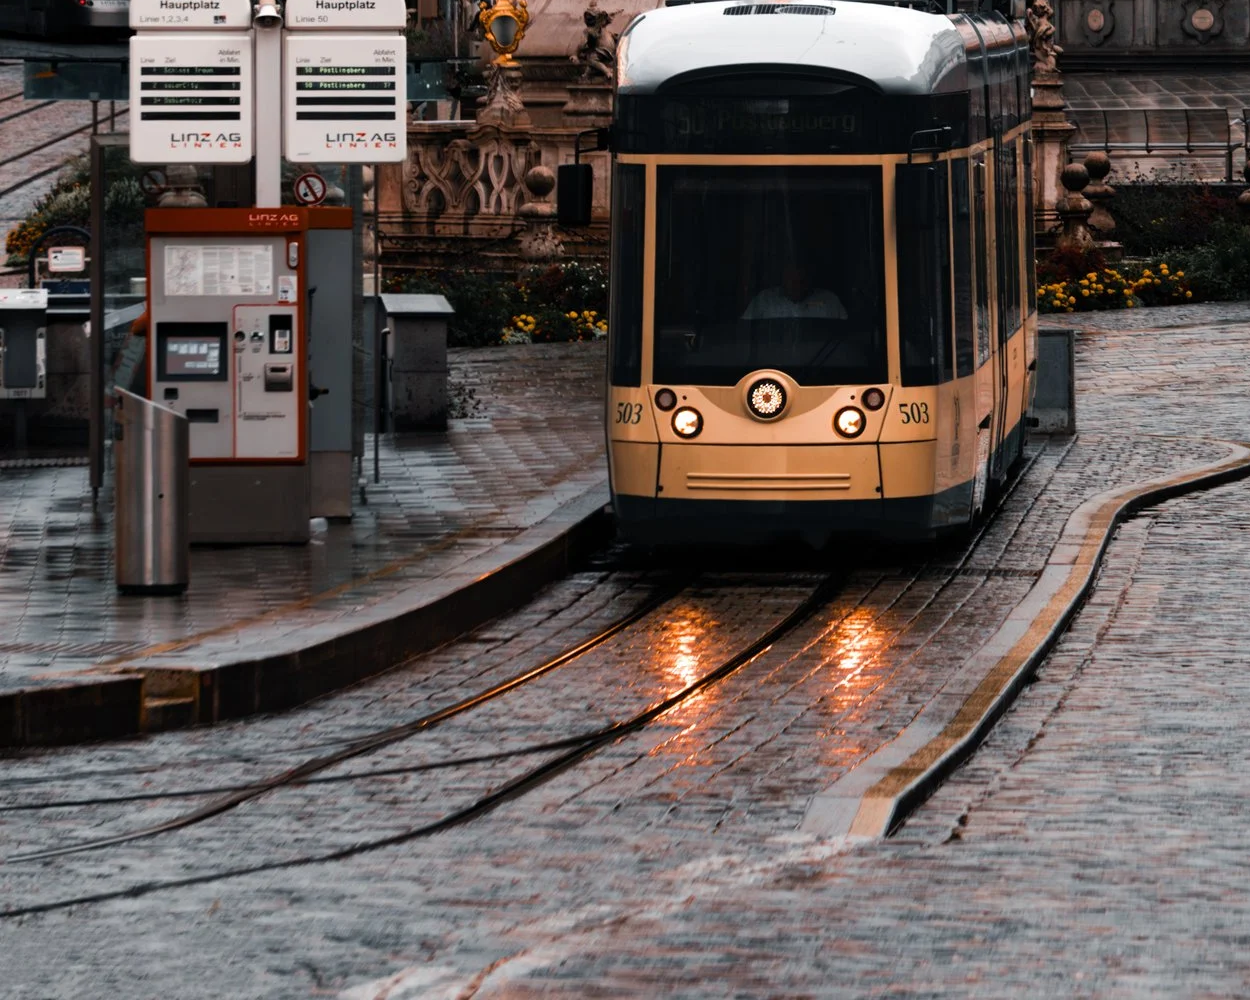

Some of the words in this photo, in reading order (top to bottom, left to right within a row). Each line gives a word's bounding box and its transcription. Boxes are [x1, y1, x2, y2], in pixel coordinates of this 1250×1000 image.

[160, 0, 220, 11] Hauptplatz
[315, 0, 376, 11] Hauptplatz
[139, 15, 159, 23] Linie
[295, 15, 315, 23] Linie
[317, 15, 329, 23] 50
[171, 133, 211, 142] LINZ
[216, 133, 242, 142] AG
[326, 133, 366, 142] LINZ
[371, 133, 397, 142] AG
[248, 213, 277, 221] LINZ
[279, 213, 300, 221] AG
[615, 401, 644, 425] 503
[898, 401, 930, 425] 503
